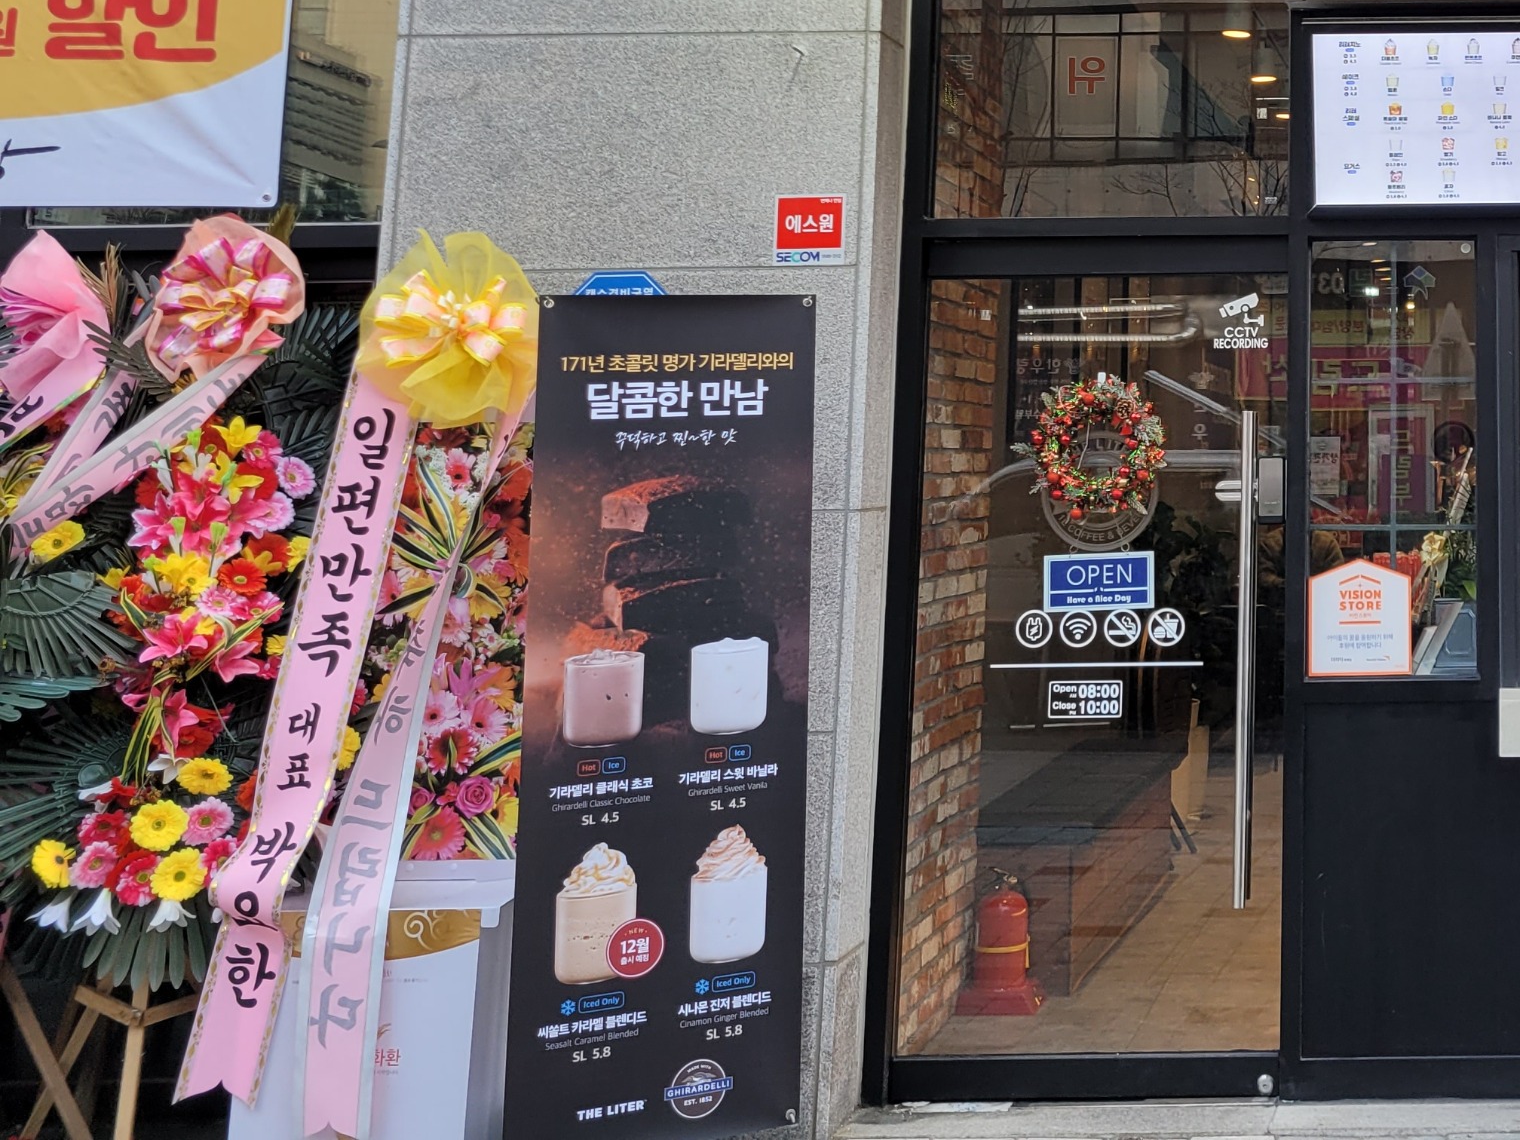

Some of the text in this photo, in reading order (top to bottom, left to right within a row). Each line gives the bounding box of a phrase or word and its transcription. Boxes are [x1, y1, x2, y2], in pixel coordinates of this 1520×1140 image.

[784, 213, 834, 234] 에스원
[776, 251, 820, 263] SECOM
[1224, 326, 1259, 338] CCTV
[1213, 337, 1269, 349] RECORDING
[560, 352, 794, 373] 171년 초콜릿 명가 기라델리와의
[587, 379, 769, 420] 달콤한 만남
[615, 430, 667, 451] 꾸덕하고
[721, 428, 738, 445] 맛
[1067, 564, 1132, 585] OPEN
[1067, 596, 1086, 604] Have
[1114, 594, 1131, 603] Day
[1339, 590, 1381, 599] VISION
[1339, 601, 1381, 611] STORE
[1053, 684, 1119, 699] Open 08:00
[224, 407, 396, 1009] 일편만족 대표 박요한
[1052, 700, 1119, 715] Close 10:00
[679, 763, 778, 785] 기라델리 스윗 바닐라
[549, 777, 653, 799] 기라델리 클래식 초코
[688, 786, 723, 797] Ghirardelli
[724, 784, 745, 792] Sweet
[552, 794, 650, 812] Ghirardelli Classic Chocolate
[710, 797, 746, 811] SL 4.5
[581, 812, 620, 826] SL 4.5
[620, 937, 649, 955] 12월
[620, 955, 634, 966] 출시
[717, 976, 751, 988] Iced Only
[583, 996, 620, 1009] Iced Only
[678, 991, 772, 1017] 시나몬 진저 블렌디드
[571, 1017, 603, 1033] 카라멜
[605, 1011, 648, 1029] 블렌디드
[714, 1013, 738, 1023] Ginger
[739, 1007, 769, 1019] Blended
[545, 1028, 639, 1050] Seasalt Caramel Blended
[706, 1024, 742, 1040] SL 5.8
[572, 1046, 611, 1062] SL 5.8
[667, 1080, 730, 1097] GHIRARDELLI
[684, 1096, 713, 1106] EST. 1852
[577, 1100, 645, 1121] THE LITER
